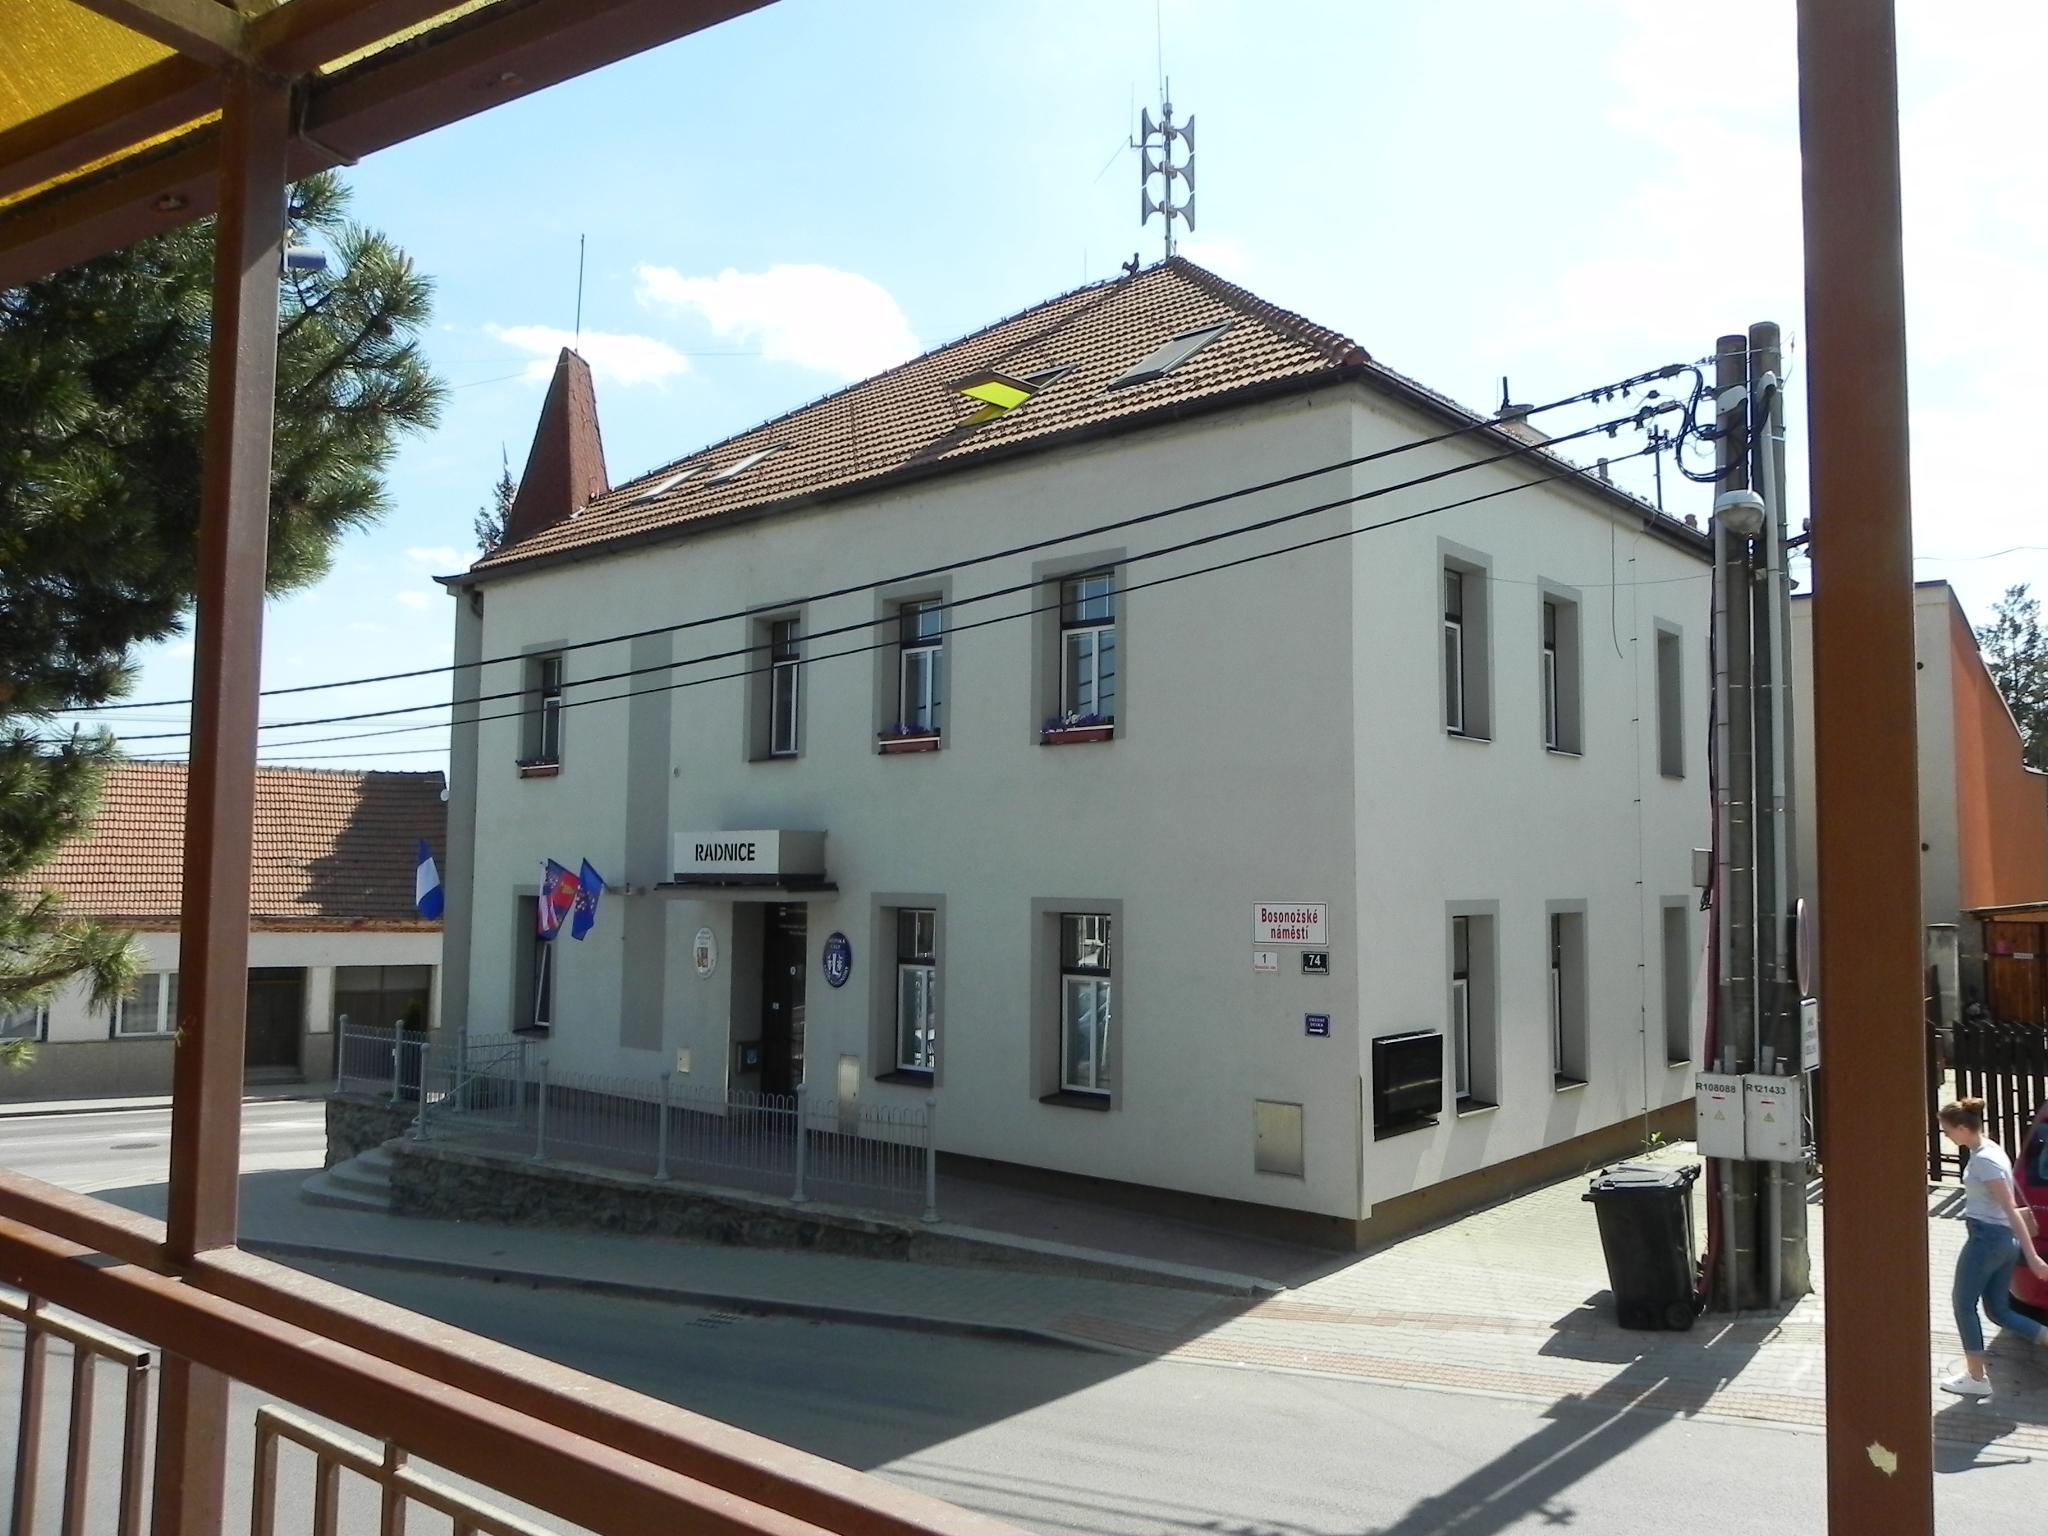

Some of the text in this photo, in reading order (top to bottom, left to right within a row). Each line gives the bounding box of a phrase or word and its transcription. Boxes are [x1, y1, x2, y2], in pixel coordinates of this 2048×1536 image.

[695, 843, 755, 861] RADNICE
[1261, 907, 1318, 923] Bosonožské
[1271, 924, 1309, 939] náměstí
[1262, 953, 1267, 963] 1
[1308, 955, 1321, 966] 74
